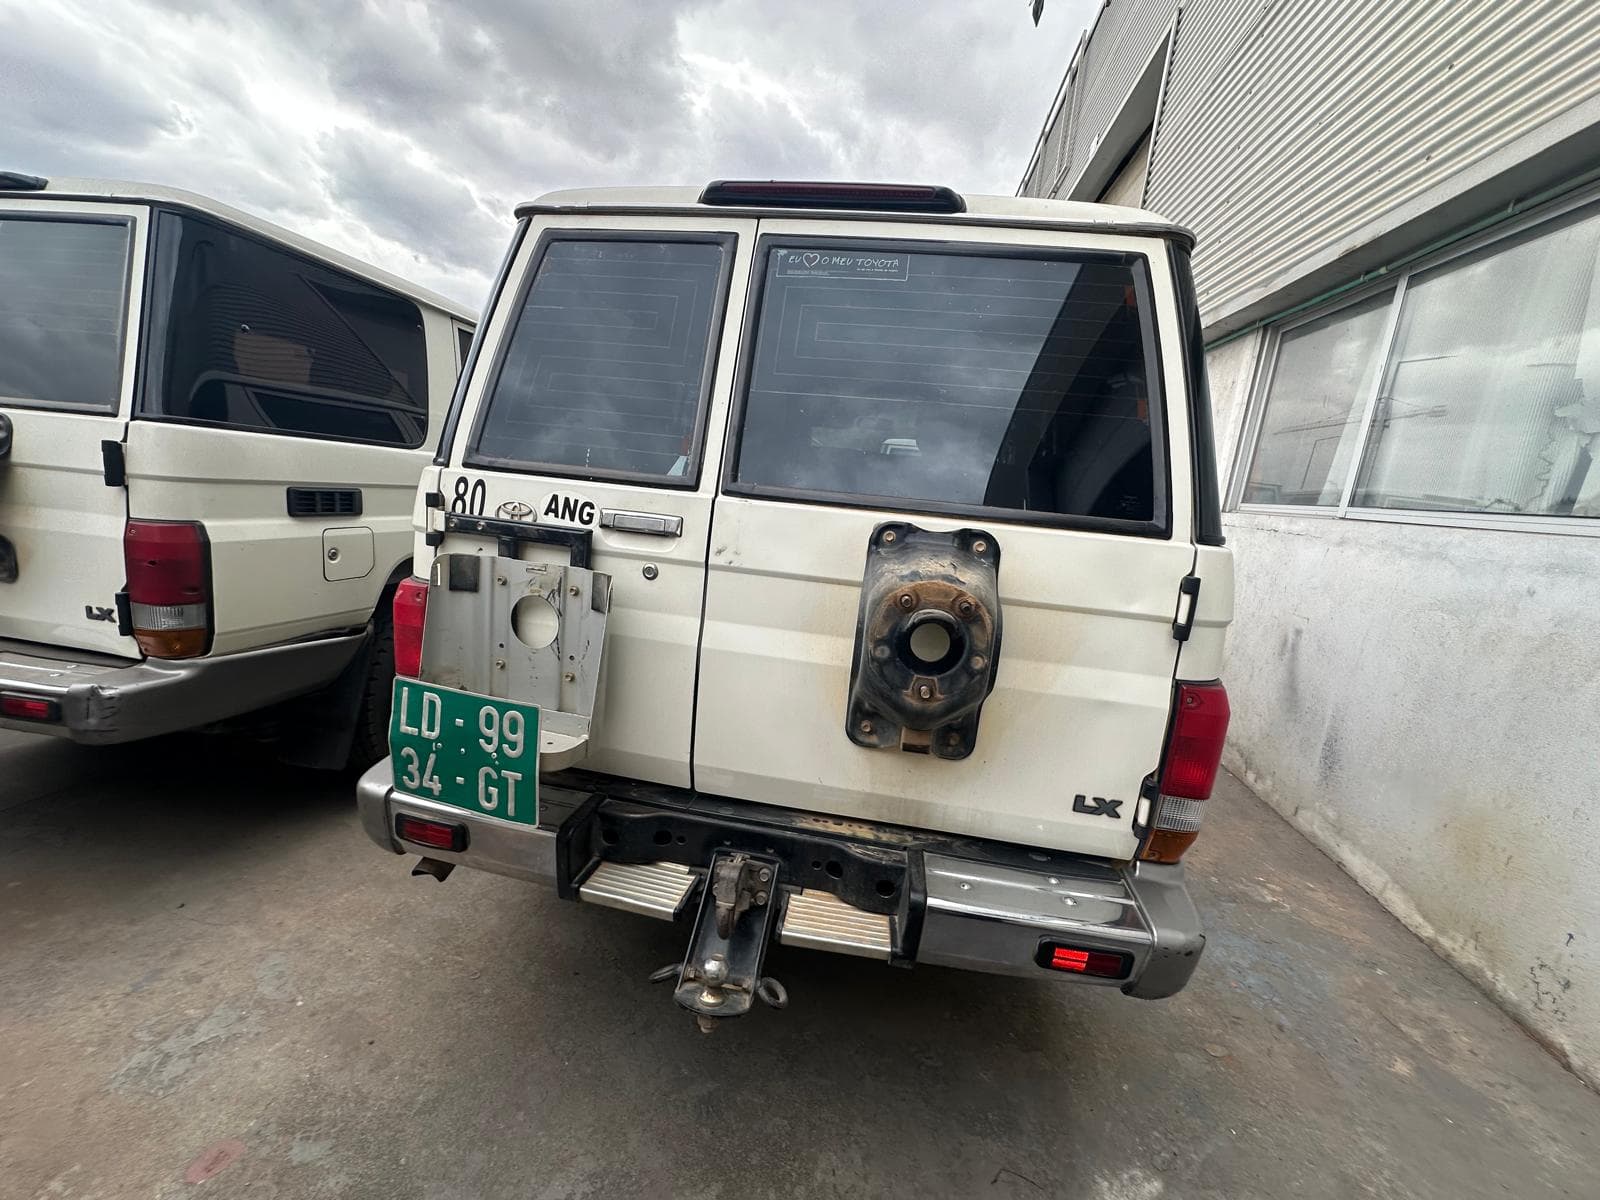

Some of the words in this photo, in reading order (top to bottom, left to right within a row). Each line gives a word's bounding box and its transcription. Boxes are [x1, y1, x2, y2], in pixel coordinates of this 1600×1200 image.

[788, 255, 801, 264] EU
[821, 256, 830, 265] O
[832, 256, 854, 266] MEU
[856, 258, 899, 268] TOYOTA
[451, 476, 487, 517] 80
[543, 493, 595, 526] ANG
[85, 605, 117, 623] LX
[1072, 794, 1123, 819] LX
